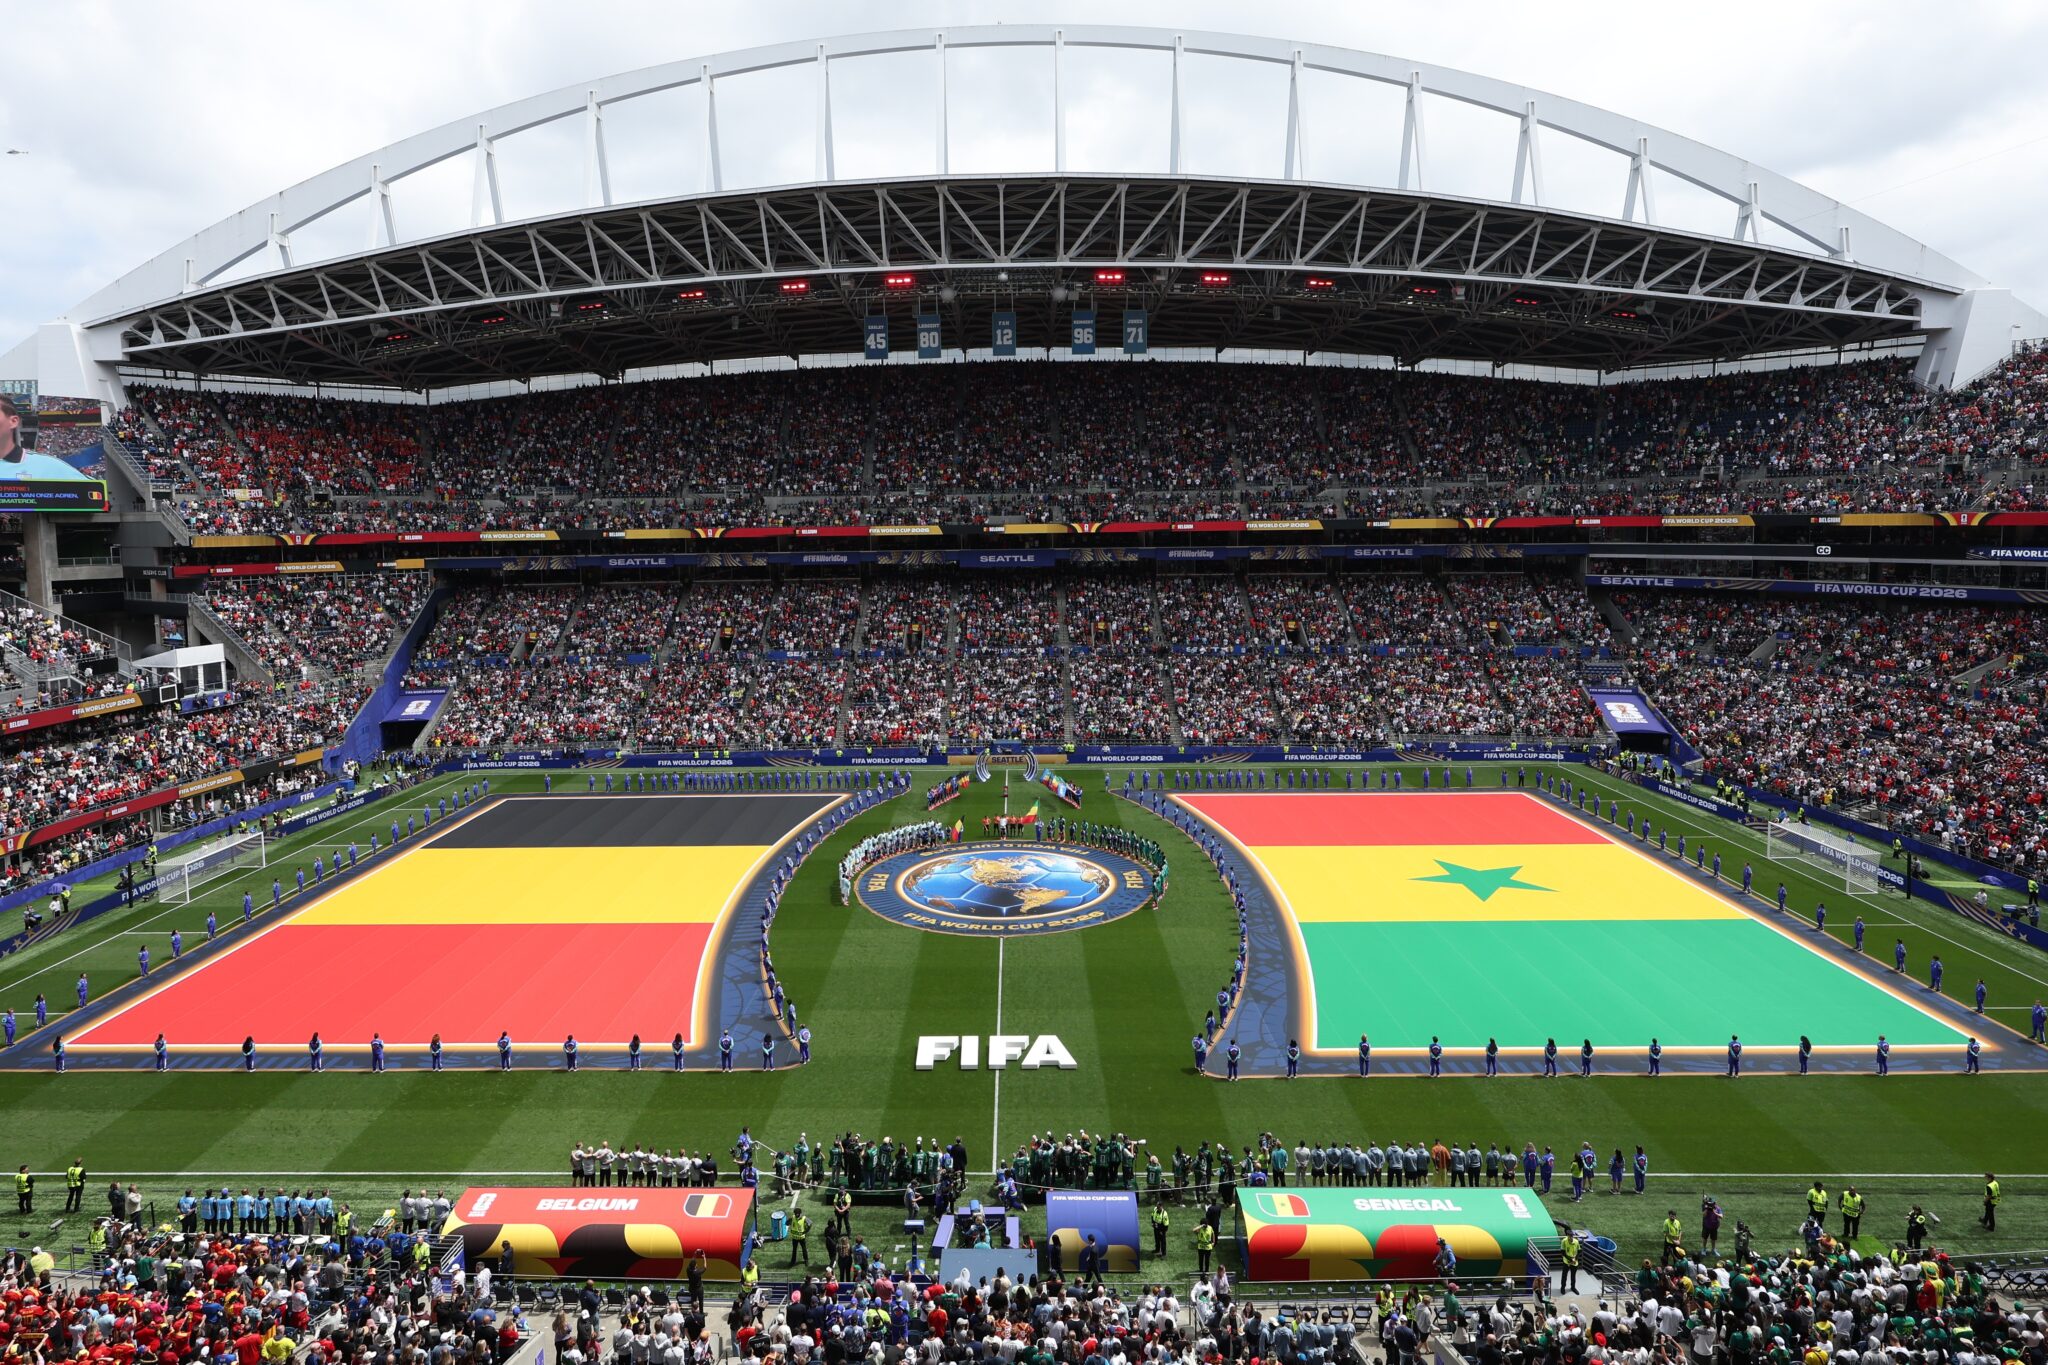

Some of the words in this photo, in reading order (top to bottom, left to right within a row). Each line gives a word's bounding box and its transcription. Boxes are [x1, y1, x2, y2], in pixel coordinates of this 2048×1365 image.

[866, 333, 887, 349] 45
[919, 332, 939, 348] 80
[996, 329, 1013, 345] 12
[1073, 328, 1094, 344] 96
[1126, 327, 1144, 344] 71
[803, 555, 848, 563] #FIFAWorldCup
[1168, 550, 1214, 558] #FIFAWorldCup
[1991, 549, 2012, 557] FIFA
[2014, 550, 2048, 558] WORLD
[609, 558, 667, 566] SEATTLE
[1601, 577, 1674, 587] SEATTLE
[1815, 584, 1841, 594] FIFA
[1843, 584, 1889, 595] WORLD
[1891, 586, 1917, 596] CUP
[1918, 587, 1968, 599] 2026
[72, 707, 85, 716] FIFA
[85, 703, 105, 713] WORLD
[105, 701, 116, 709] CUP
[117, 697, 136, 707] 2026
[178, 787, 190, 796] FIFA
[191, 784, 207, 793] WORLD
[207, 781, 217, 789] CUP
[218, 776, 233, 785] 2026
[300, 792, 315, 802] FIFA
[1658, 784, 1669, 793] FIFA
[1669, 788, 1687, 800] WORLD
[1687, 795, 1698, 804] CUP
[1698, 799, 1718, 811] 2026
[306, 815, 318, 825] FIFA
[317, 808, 337, 821] WORLD
[337, 804, 348, 813] CUP
[347, 797, 365, 809] 2026
[1820, 845, 1835, 857] FIFA
[1861, 860, 1877, 873] CUP
[1877, 867, 1904, 885] 2026
[121, 888, 139, 901] FIA
[138, 876, 166, 894] WORLD
[166, 870, 181, 882] CUP
[903, 912, 937, 925] FIFA
[939, 920, 1004, 931] WORLD
[1008, 921, 1044, 931] CUP
[1047, 910, 1105, 927] 2026
[916, 1035, 1078, 1070] FIFA
[536, 1198, 639, 1211] BELGIUM
[1352, 1198, 1462, 1212] SENEGAL
